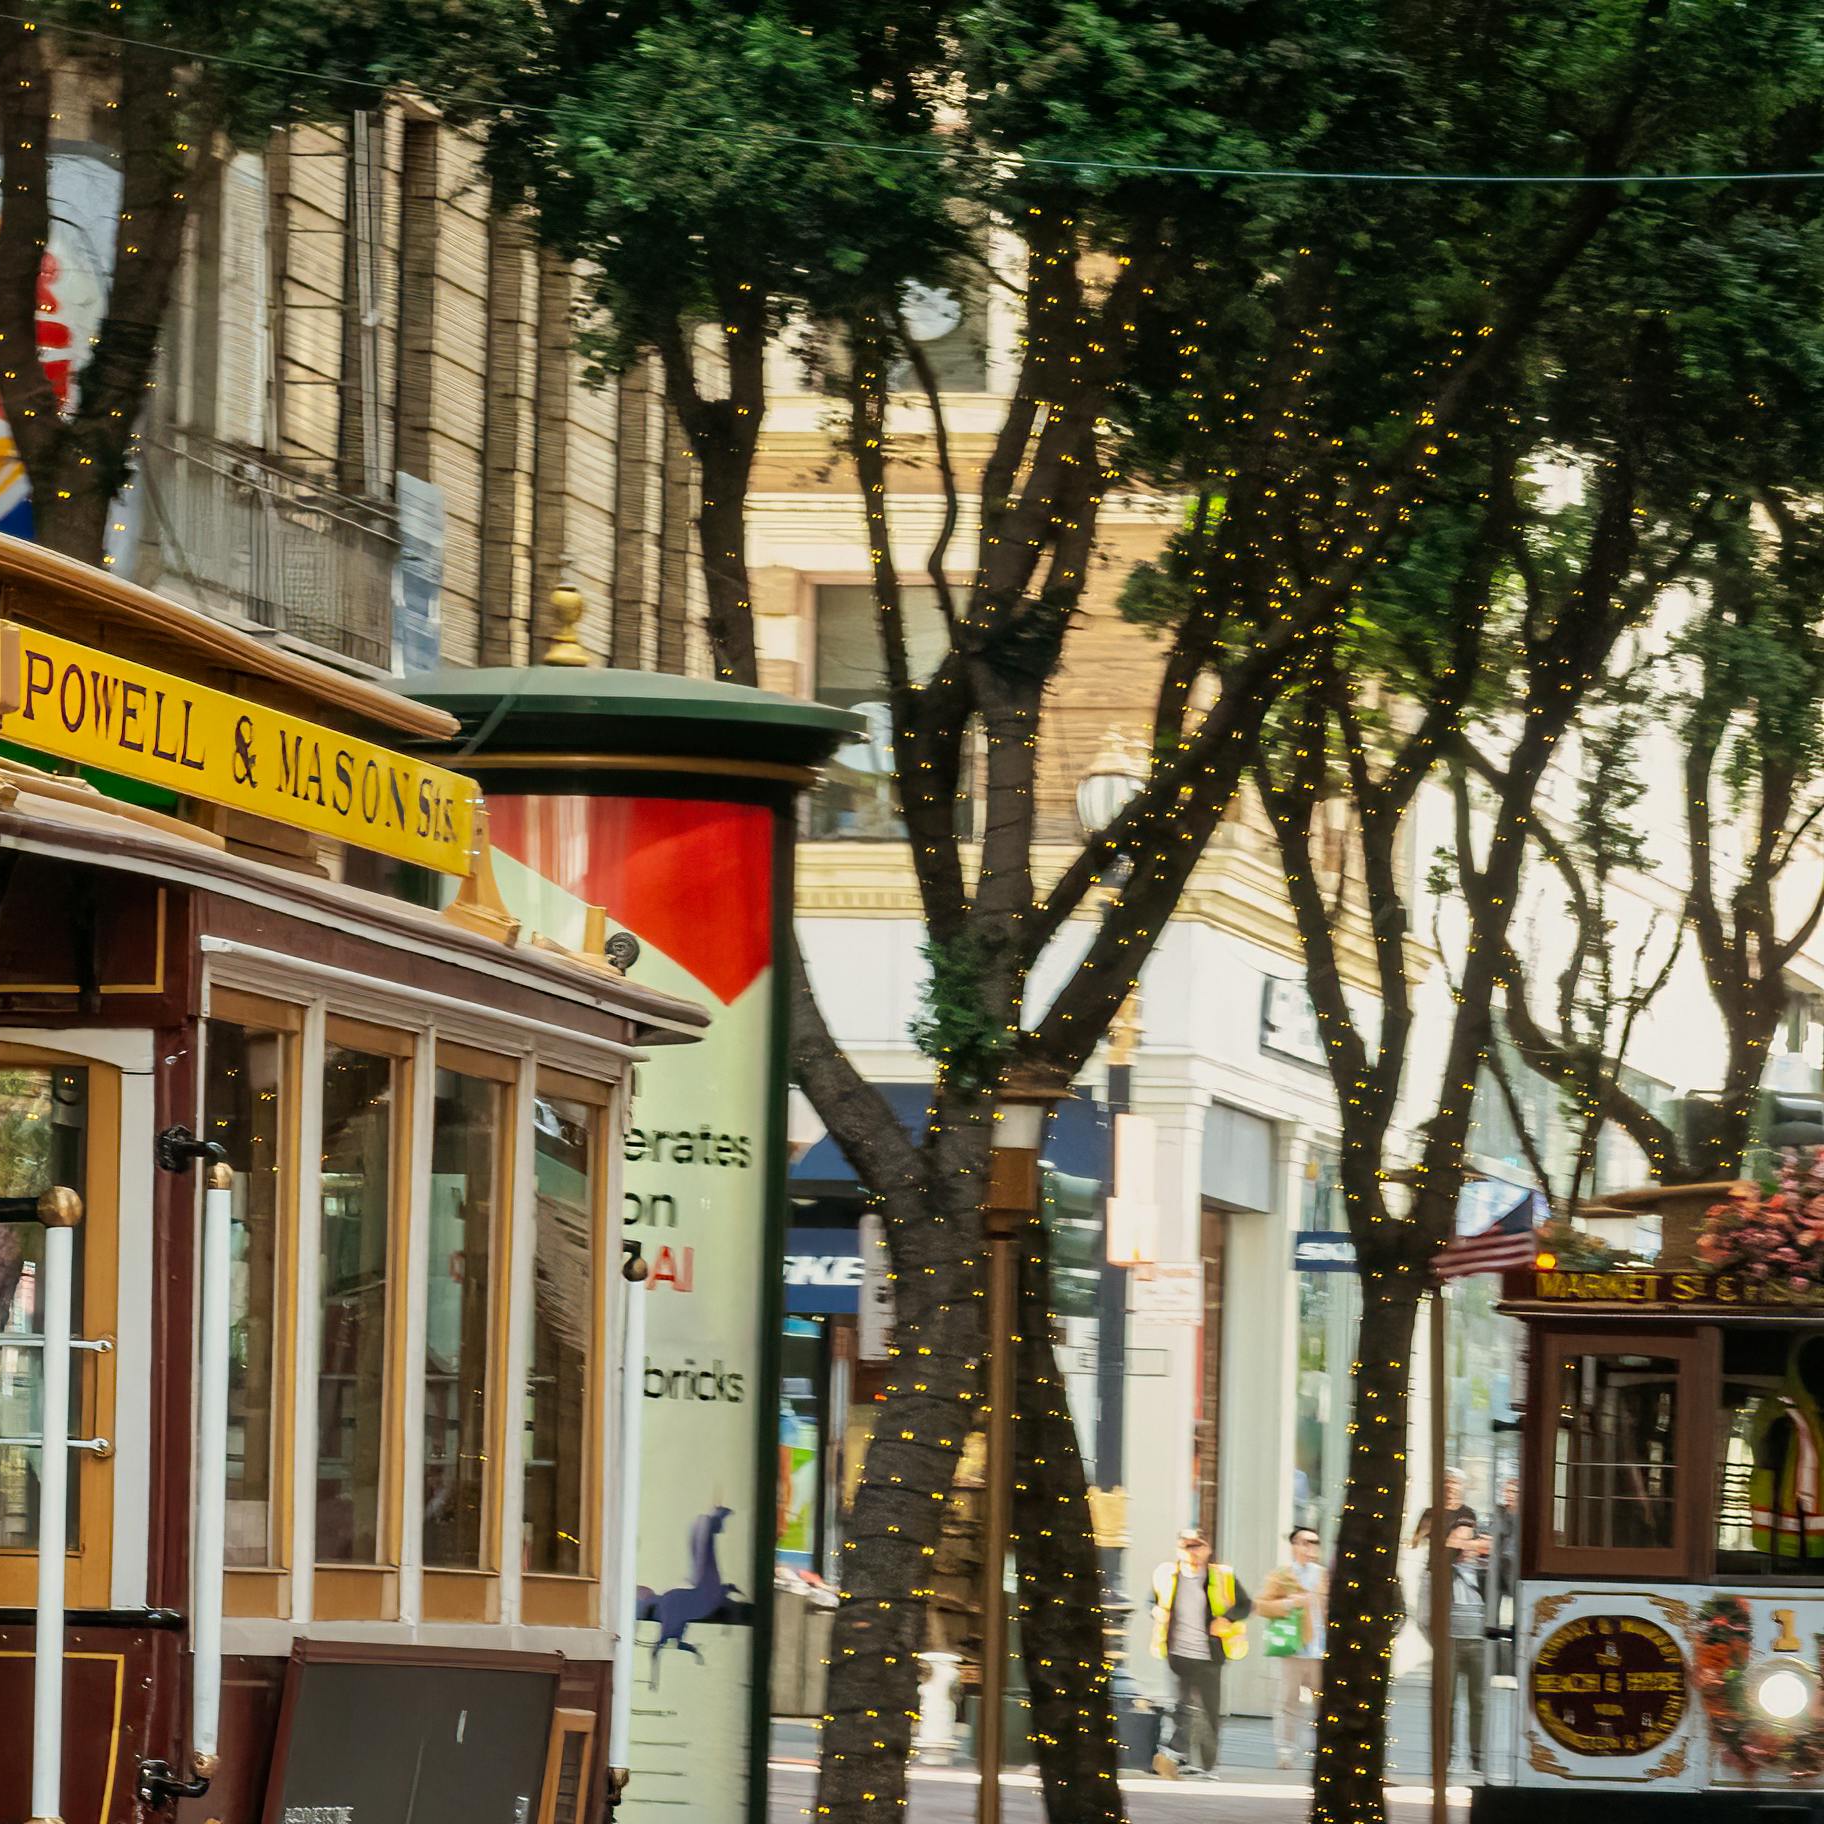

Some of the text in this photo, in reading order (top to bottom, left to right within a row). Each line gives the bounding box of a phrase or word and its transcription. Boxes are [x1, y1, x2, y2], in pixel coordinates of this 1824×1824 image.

[21, 649, 206, 771] POWELL
[232, 714, 258, 789] &
[276, 729, 410, 832] MASON
